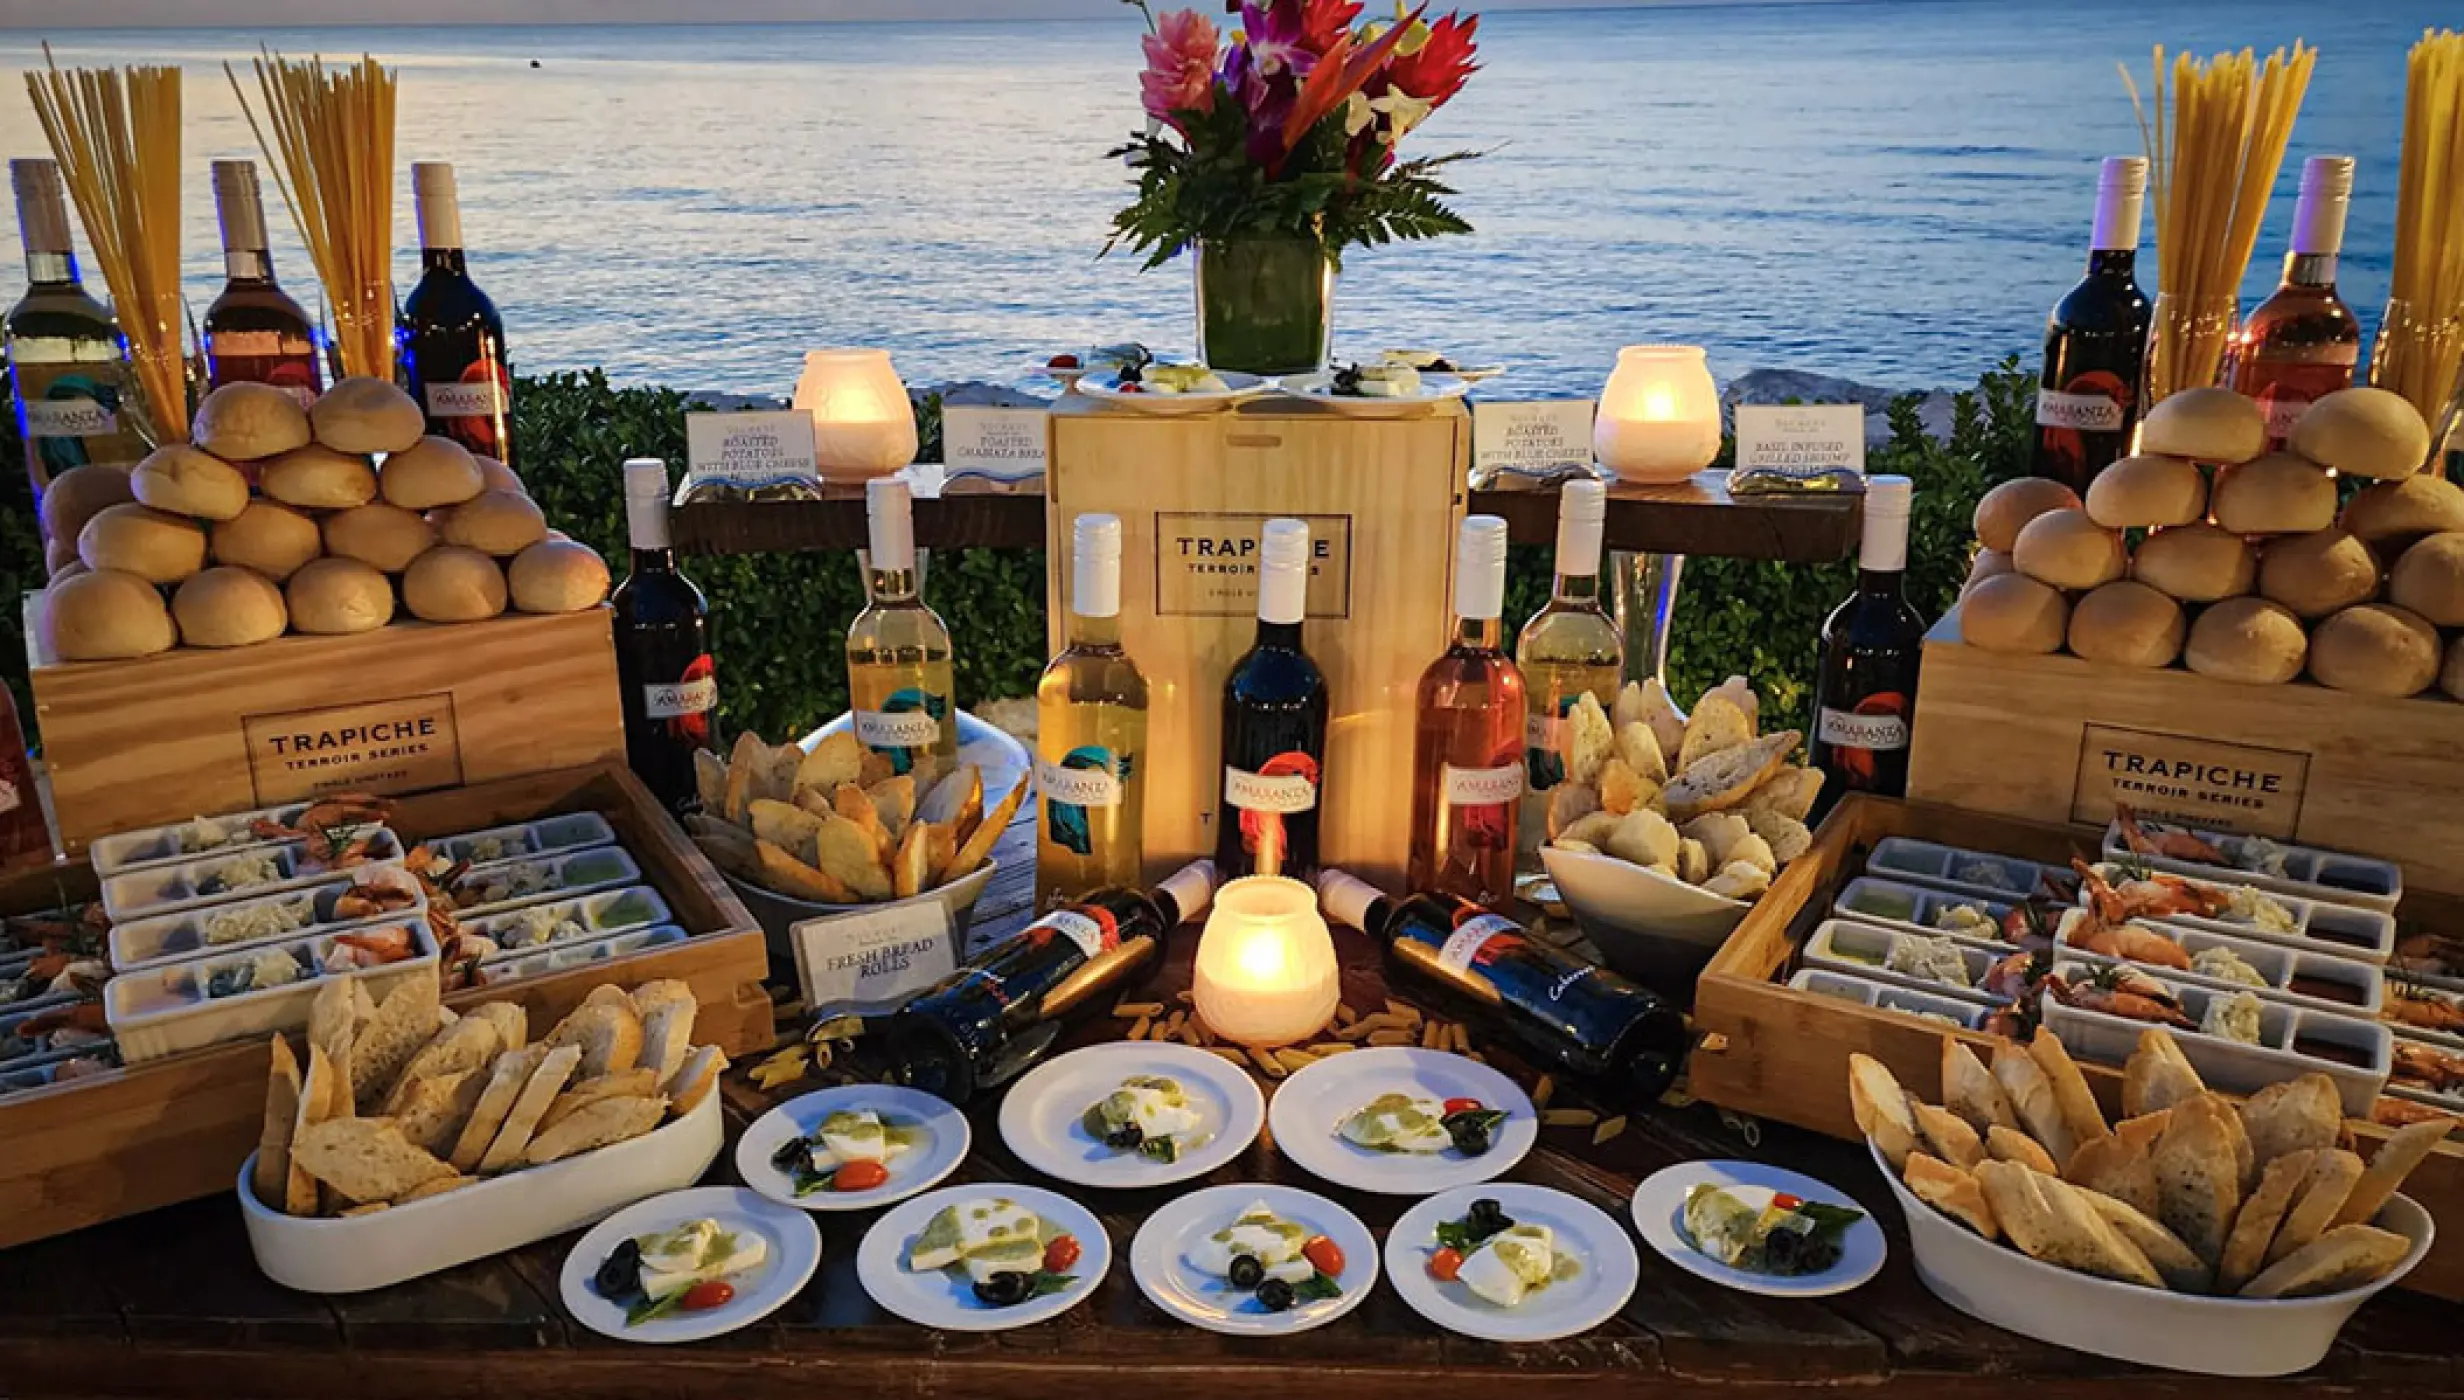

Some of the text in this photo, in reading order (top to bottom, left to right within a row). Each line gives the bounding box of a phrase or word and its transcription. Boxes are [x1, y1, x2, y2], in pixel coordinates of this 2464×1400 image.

[1177, 537, 1330, 558] TRAPE
[1188, 562, 1256, 575] TERROIR
[268, 716, 437, 756] TRAPICHE
[284, 743, 430, 773] TERROIR SERIES
[2102, 750, 2283, 793] TRAPICHE
[2112, 777, 2266, 810] TERROIR SERIES
[826, 948, 878, 971] FRESH
[881, 937, 934, 958] BREAD
[860, 955, 911, 979] ROLLS
